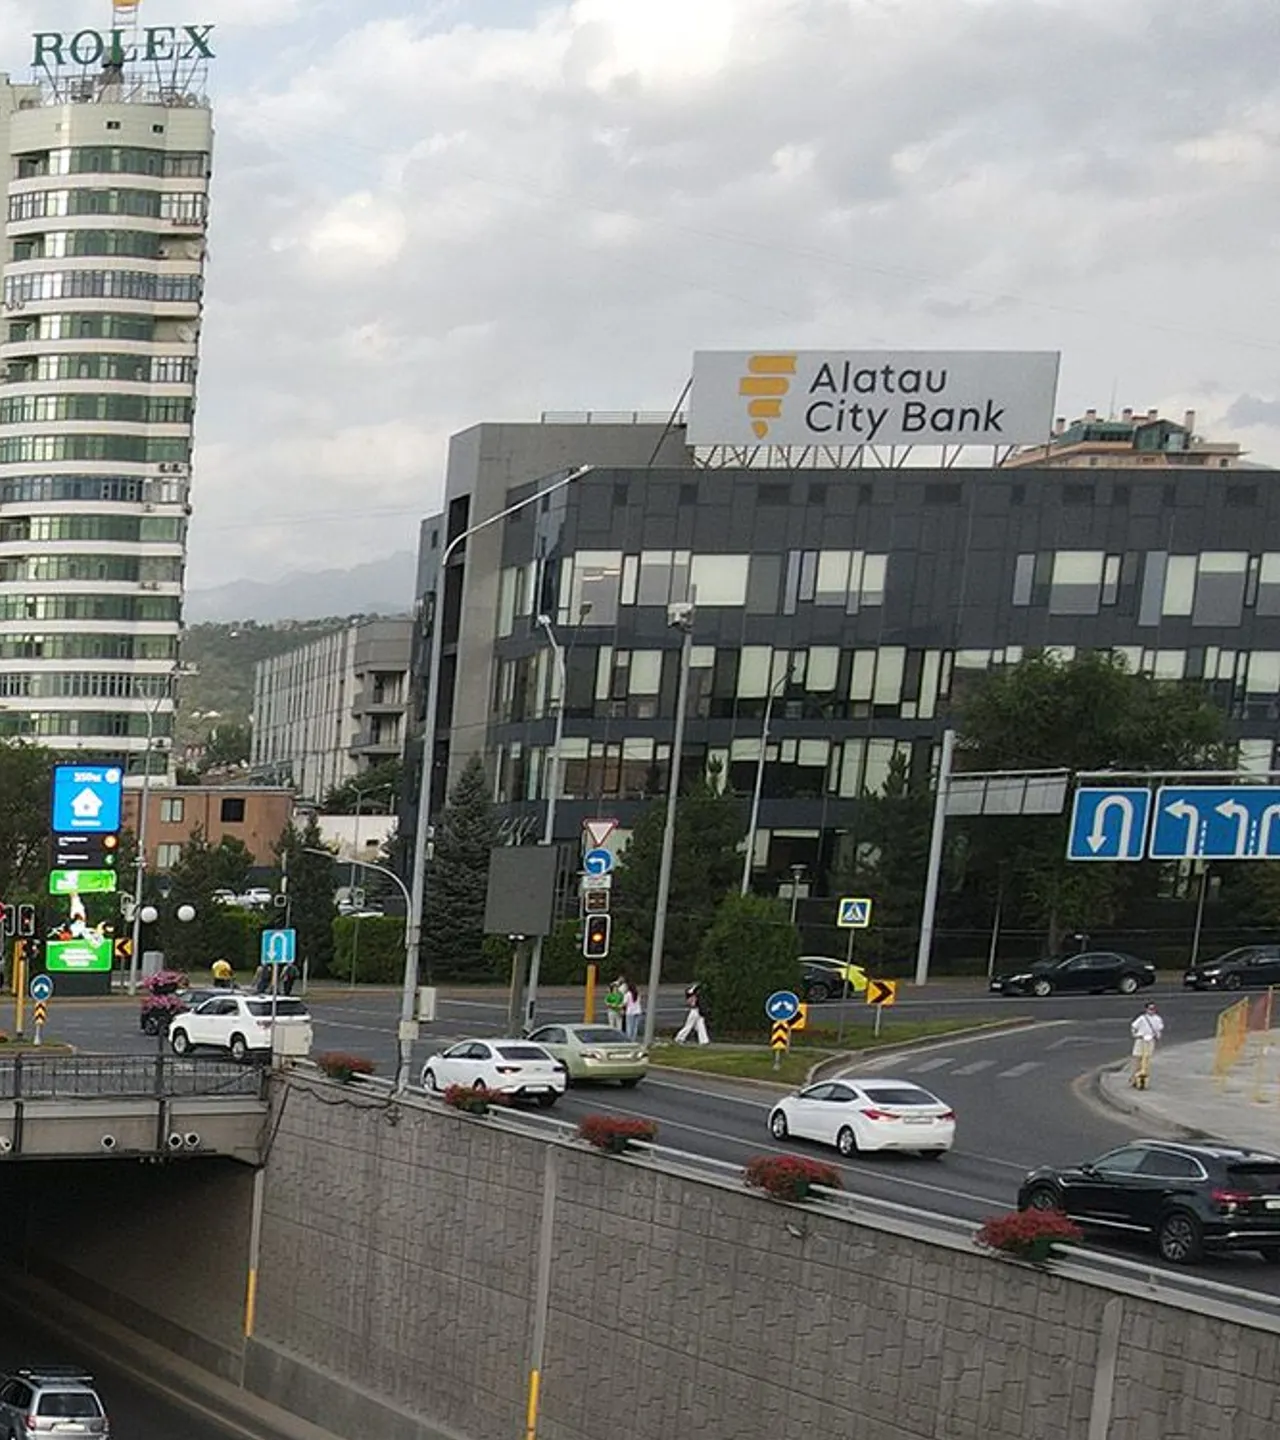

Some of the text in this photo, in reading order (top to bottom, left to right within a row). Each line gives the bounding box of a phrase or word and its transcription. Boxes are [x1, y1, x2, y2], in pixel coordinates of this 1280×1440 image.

[30, 24, 216, 67] ROLEX
[809, 361, 947, 394] Alatau
[805, 399, 1005, 440] City Bank
